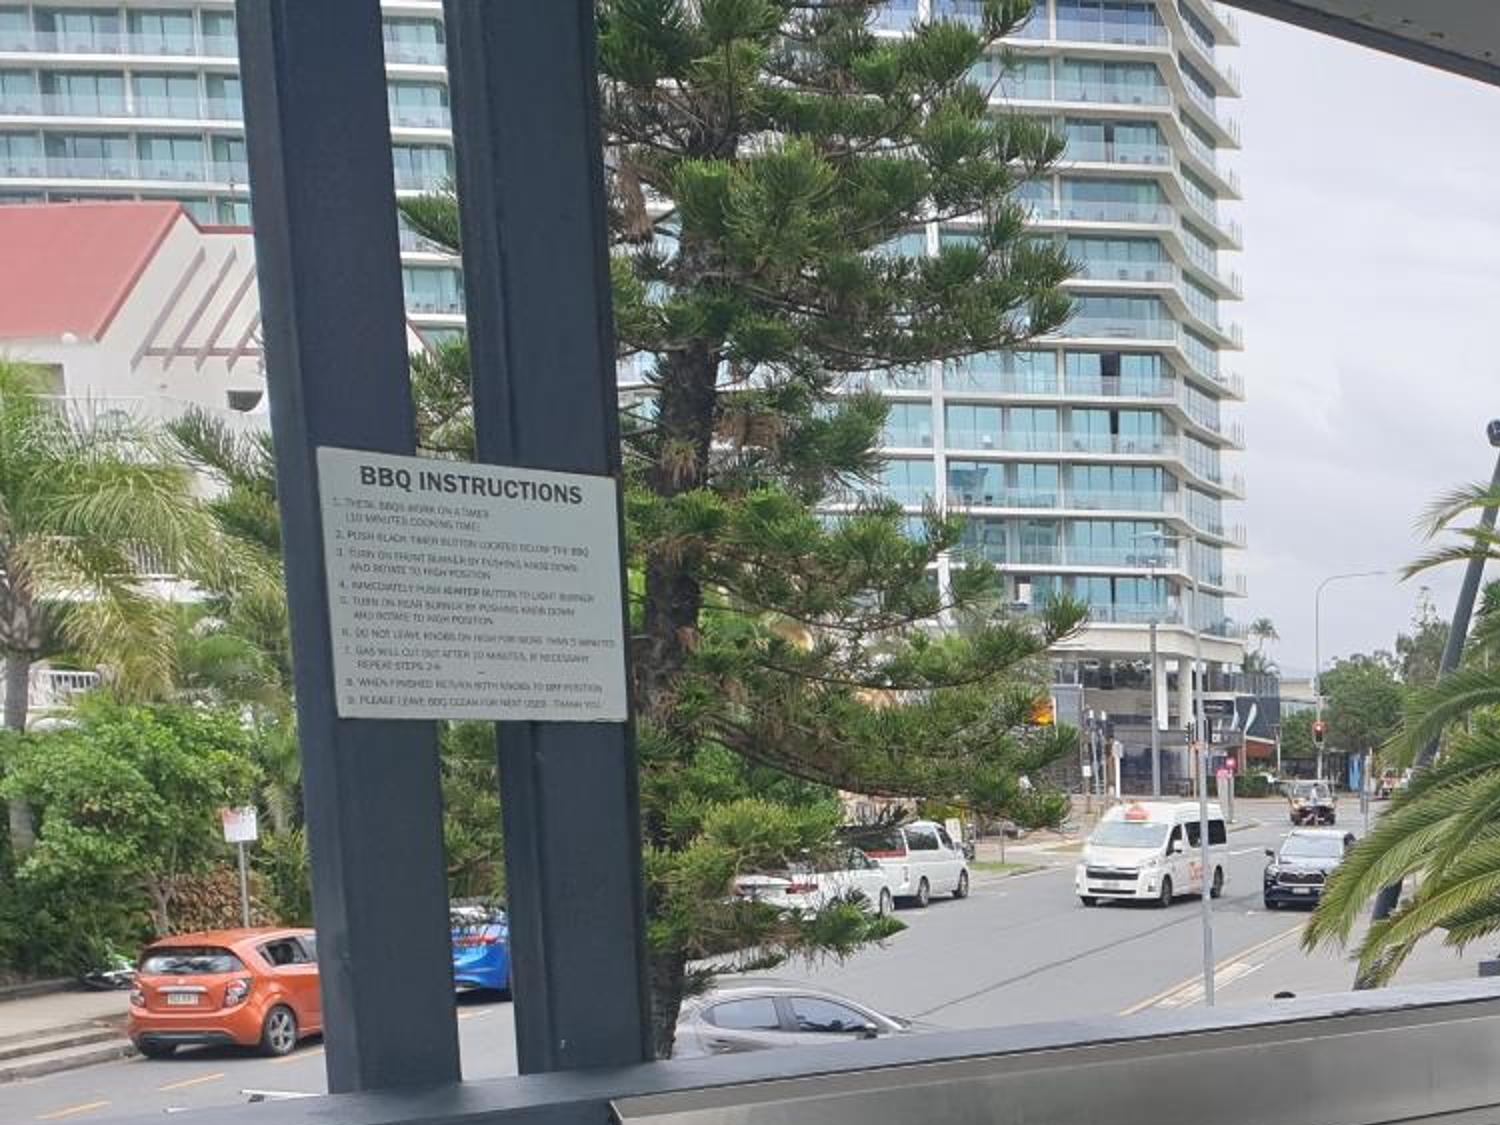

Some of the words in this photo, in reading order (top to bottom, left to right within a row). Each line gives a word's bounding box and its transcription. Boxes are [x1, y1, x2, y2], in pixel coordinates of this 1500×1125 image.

[360, 465, 411, 492] BBQ
[419, 471, 583, 504] INSTRUCTIONS
[347, 530, 374, 541] PUSH
